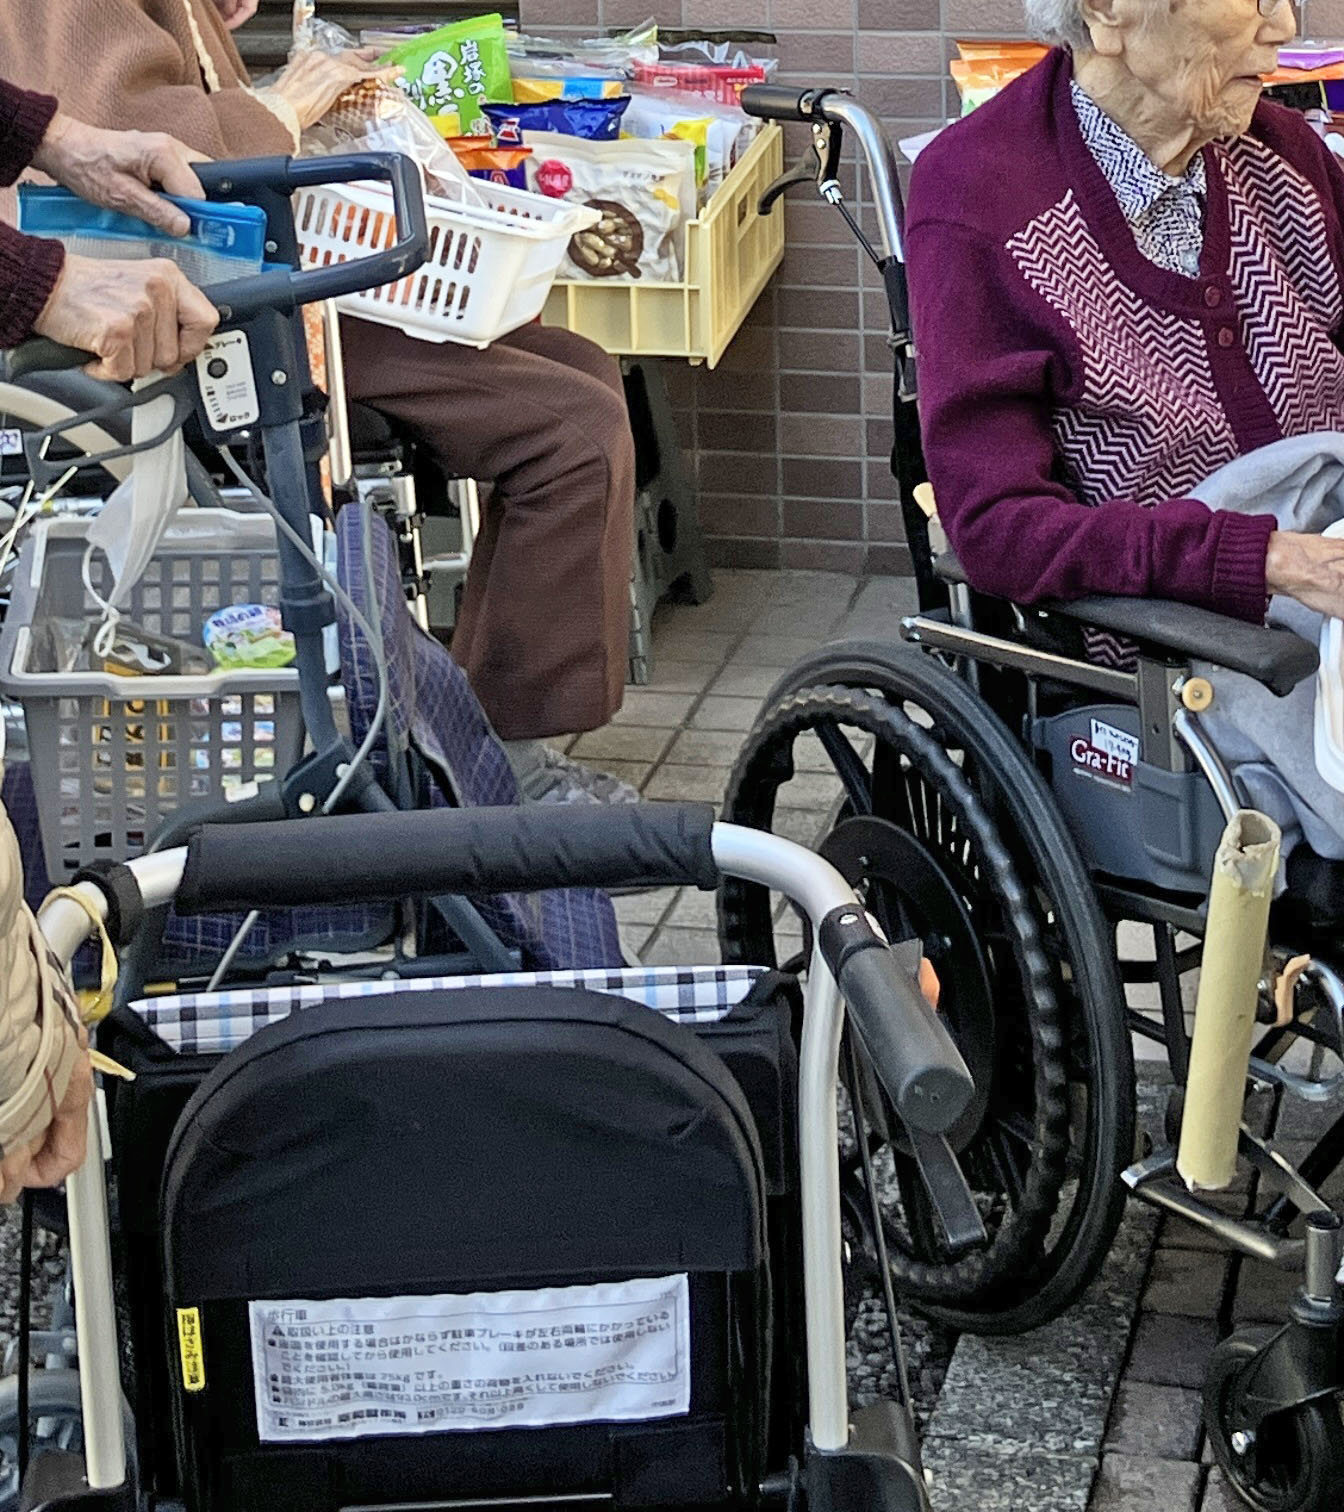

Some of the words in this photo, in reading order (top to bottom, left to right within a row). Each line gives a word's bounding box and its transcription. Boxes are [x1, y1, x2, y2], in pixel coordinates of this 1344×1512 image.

[460, 39, 487, 95] 岩塚の
[1071, 739, 1130, 779] Gra-Fit
